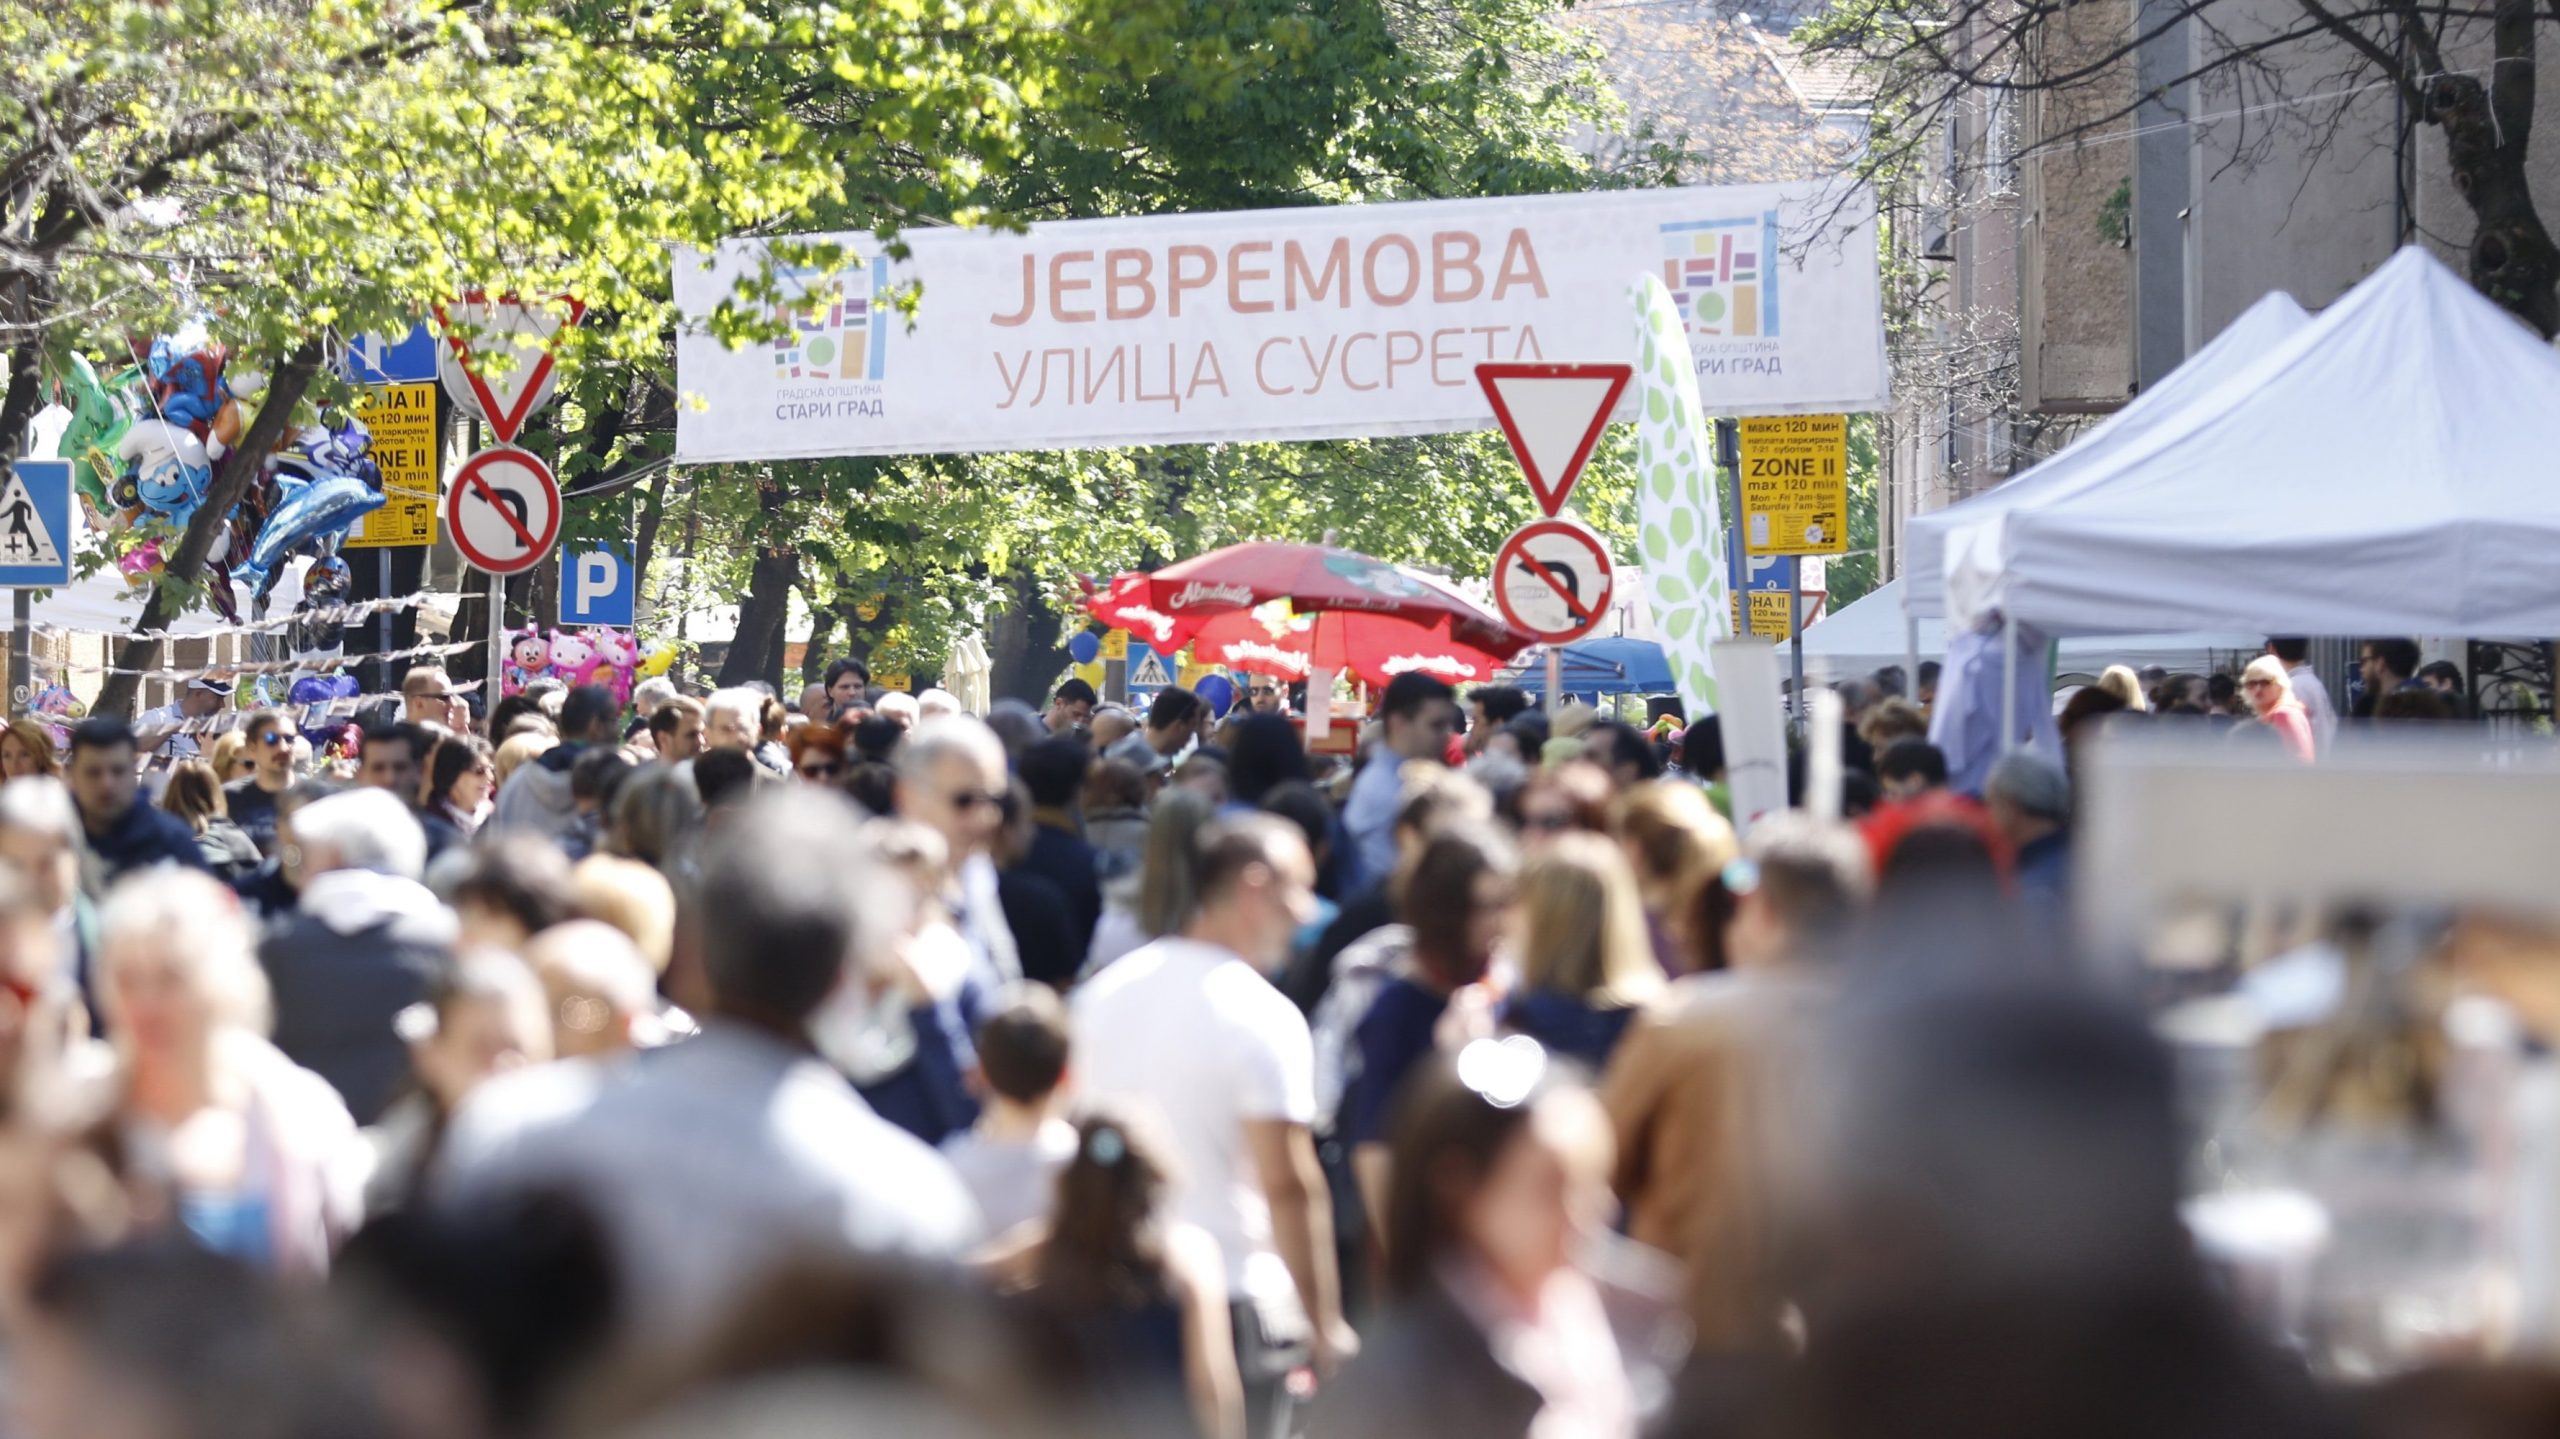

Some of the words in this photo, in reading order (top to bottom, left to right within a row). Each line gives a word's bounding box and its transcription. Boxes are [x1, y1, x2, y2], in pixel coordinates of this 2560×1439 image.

[990, 228, 1550, 327] ЈЕВРЕМОВА
[1731, 356, 1782, 376] ГРАД
[993, 341, 1229, 413] УЛИЦА
[827, 384, 882, 398] ОПШТИНА
[776, 402, 832, 420] СТАРИ
[837, 399, 885, 418] ГРАД
[381, 413, 401, 424] 120
[405, 415, 429, 423] мин
[1747, 424, 1782, 433] макс
[1785, 421, 1808, 432] 120
[1811, 423, 1840, 431] мин
[366, 450, 408, 467] ONE
[1751, 458, 1816, 476] ZONE
[384, 470, 401, 481] 20
[405, 471, 429, 480] min
[1748, 481, 1777, 490] max
[1783, 479, 1807, 490] 120
[1812, 480, 1839, 489] min
[577, 550, 618, 614] P
